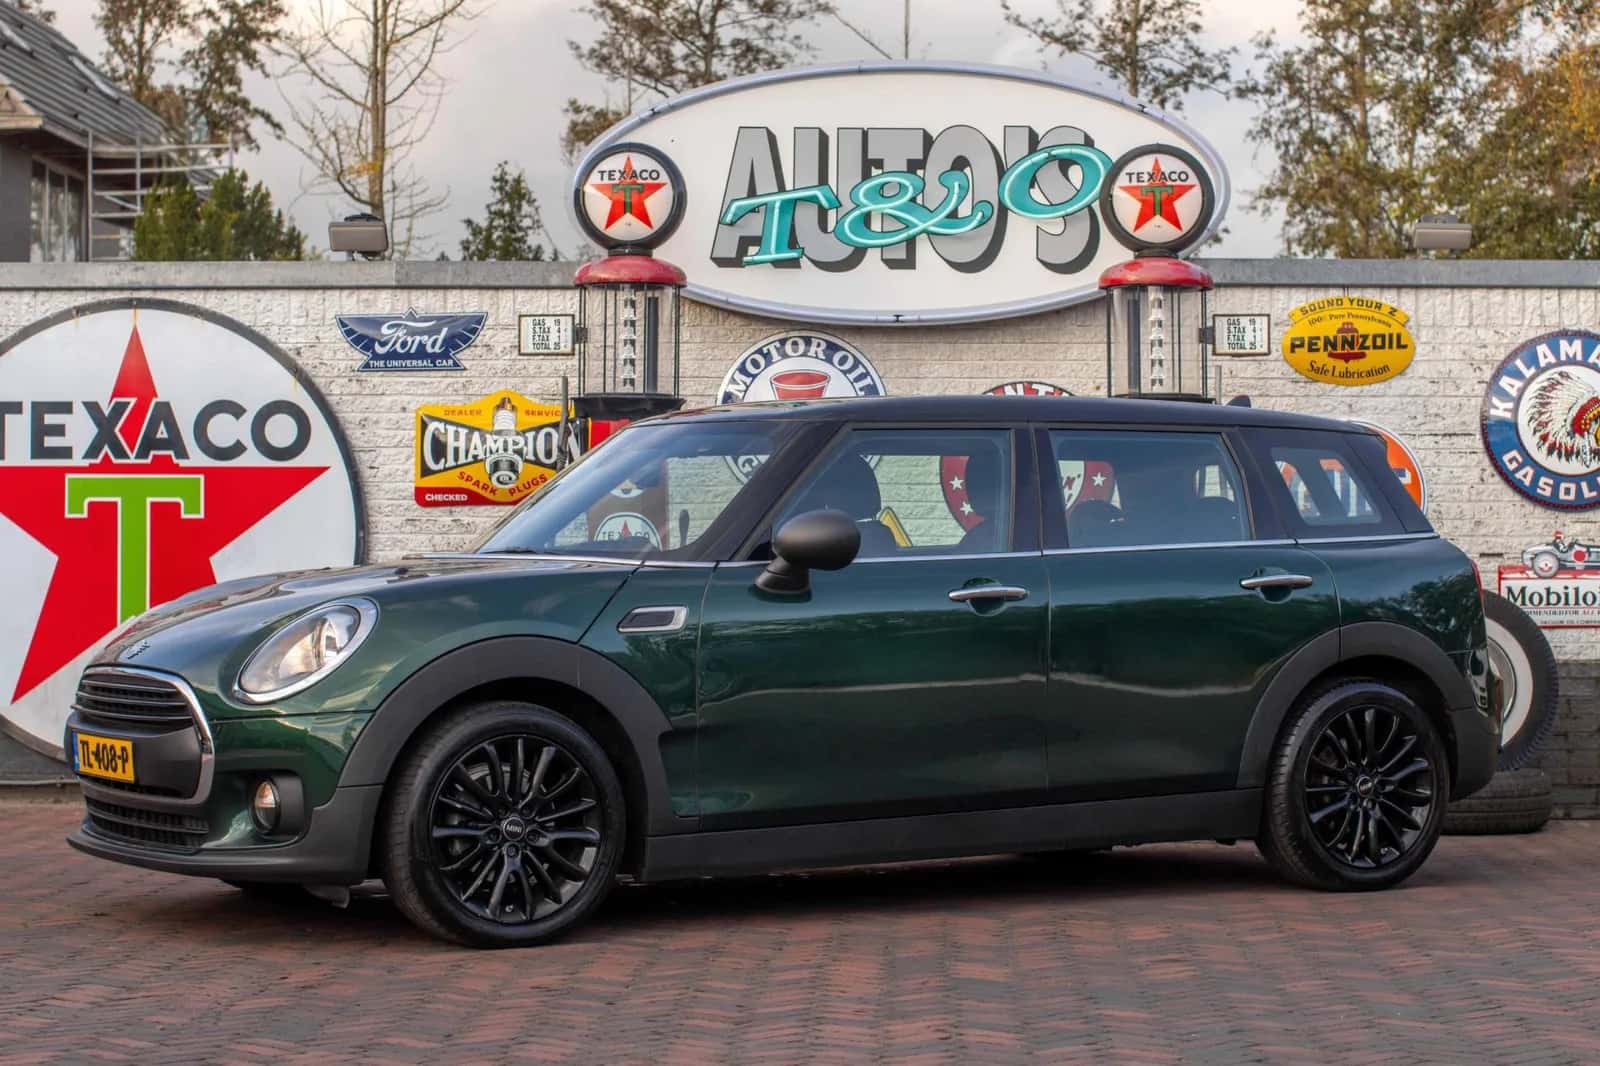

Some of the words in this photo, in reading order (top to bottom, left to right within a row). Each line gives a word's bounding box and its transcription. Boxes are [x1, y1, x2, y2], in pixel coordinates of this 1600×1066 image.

[597, 169, 660, 181] TEXACO
[1125, 171, 1190, 183] TEXACO
[1299, 298, 1344, 315] SOUND
[1345, 298, 1383, 310] YOUR
[1388, 307, 1398, 316] Z
[532, 318, 546, 327] GAS
[1226, 318, 1241, 326] GAS
[374, 320, 449, 355] Ford
[1290, 332, 1409, 354] PENNZOIL
[532, 342, 551, 350] TOTAL
[1227, 342, 1247, 350] TOTAL
[369, 360, 386, 368] THE
[386, 360, 434, 368] UNIVERSAL
[436, 359, 454, 368] CAR
[726, 337, 827, 399] MOTOR
[832, 350, 874, 396] OIL
[1308, 360, 1330, 377] Safe
[1331, 363, 1391, 379] Lubrication
[443, 409, 482, 417] DEALER
[524, 409, 561, 417] SERVIC
[423, 420, 582, 471] CHAMPION
[1502, 449, 1600, 500] GASOL
[457, 471, 499, 496] SPARK
[508, 473, 548, 496] PLUGS
[425, 493, 468, 502] CHECKED
[1506, 585, 1600, 607] Mobilo
[506, 824, 523, 833] MINI
